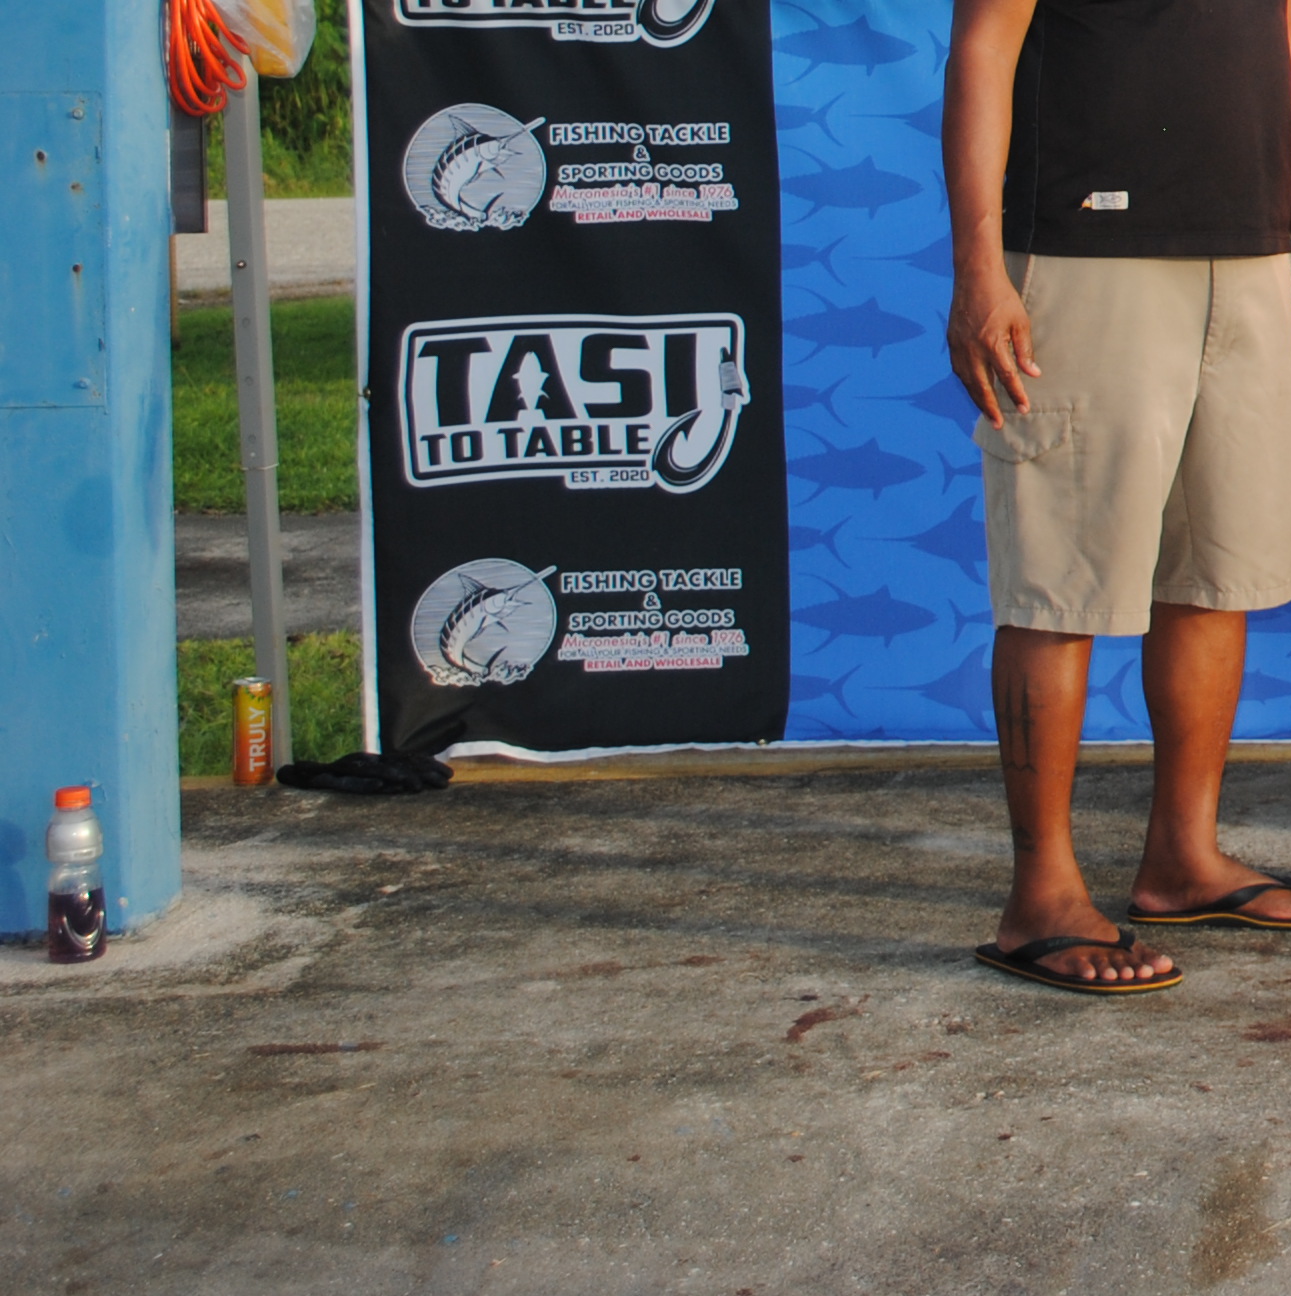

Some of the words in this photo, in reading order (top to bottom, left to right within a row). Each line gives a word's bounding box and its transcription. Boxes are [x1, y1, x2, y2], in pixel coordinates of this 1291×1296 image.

[558, 23, 589, 36] EST.
[594, 23, 634, 36] 2020
[551, 124, 643, 143] FISHING
[648, 124, 728, 143] TACKLE
[635, 146, 648, 159] &
[560, 165, 651, 180] SPORTING
[657, 165, 722, 180] GOODS
[553, 185, 639, 199] Micronesia's
[644, 185, 659, 197] #1
[665, 185, 696, 197] since
[702, 185, 733, 197] 1976
[577, 212, 612, 221] RETAIL
[618, 211, 643, 219] AND
[646, 210, 710, 219] WHOLESALE
[418, 333, 698, 427] TASI
[420, 430, 483, 466] TO
[498, 424, 652, 458] TABLE
[571, 471, 605, 483] EST.
[610, 470, 649, 482] 2020
[563, 573, 656, 591] FISHING
[662, 570, 741, 589] TACKLE
[645, 594, 659, 607] &
[571, 612, 662, 629] SPORTING
[667, 611, 733, 626] GOODS
[564, 633, 648, 648] Micronesia's
[652, 633, 667, 646] #1
[674, 633, 706, 645] since
[713, 631, 743, 644] 1976
[587, 660, 622, 669] RETAIL
[627, 659, 651, 668] AND
[655, 657, 721, 667] WHOLESALE
[249, 707, 266, 772] TRULY
